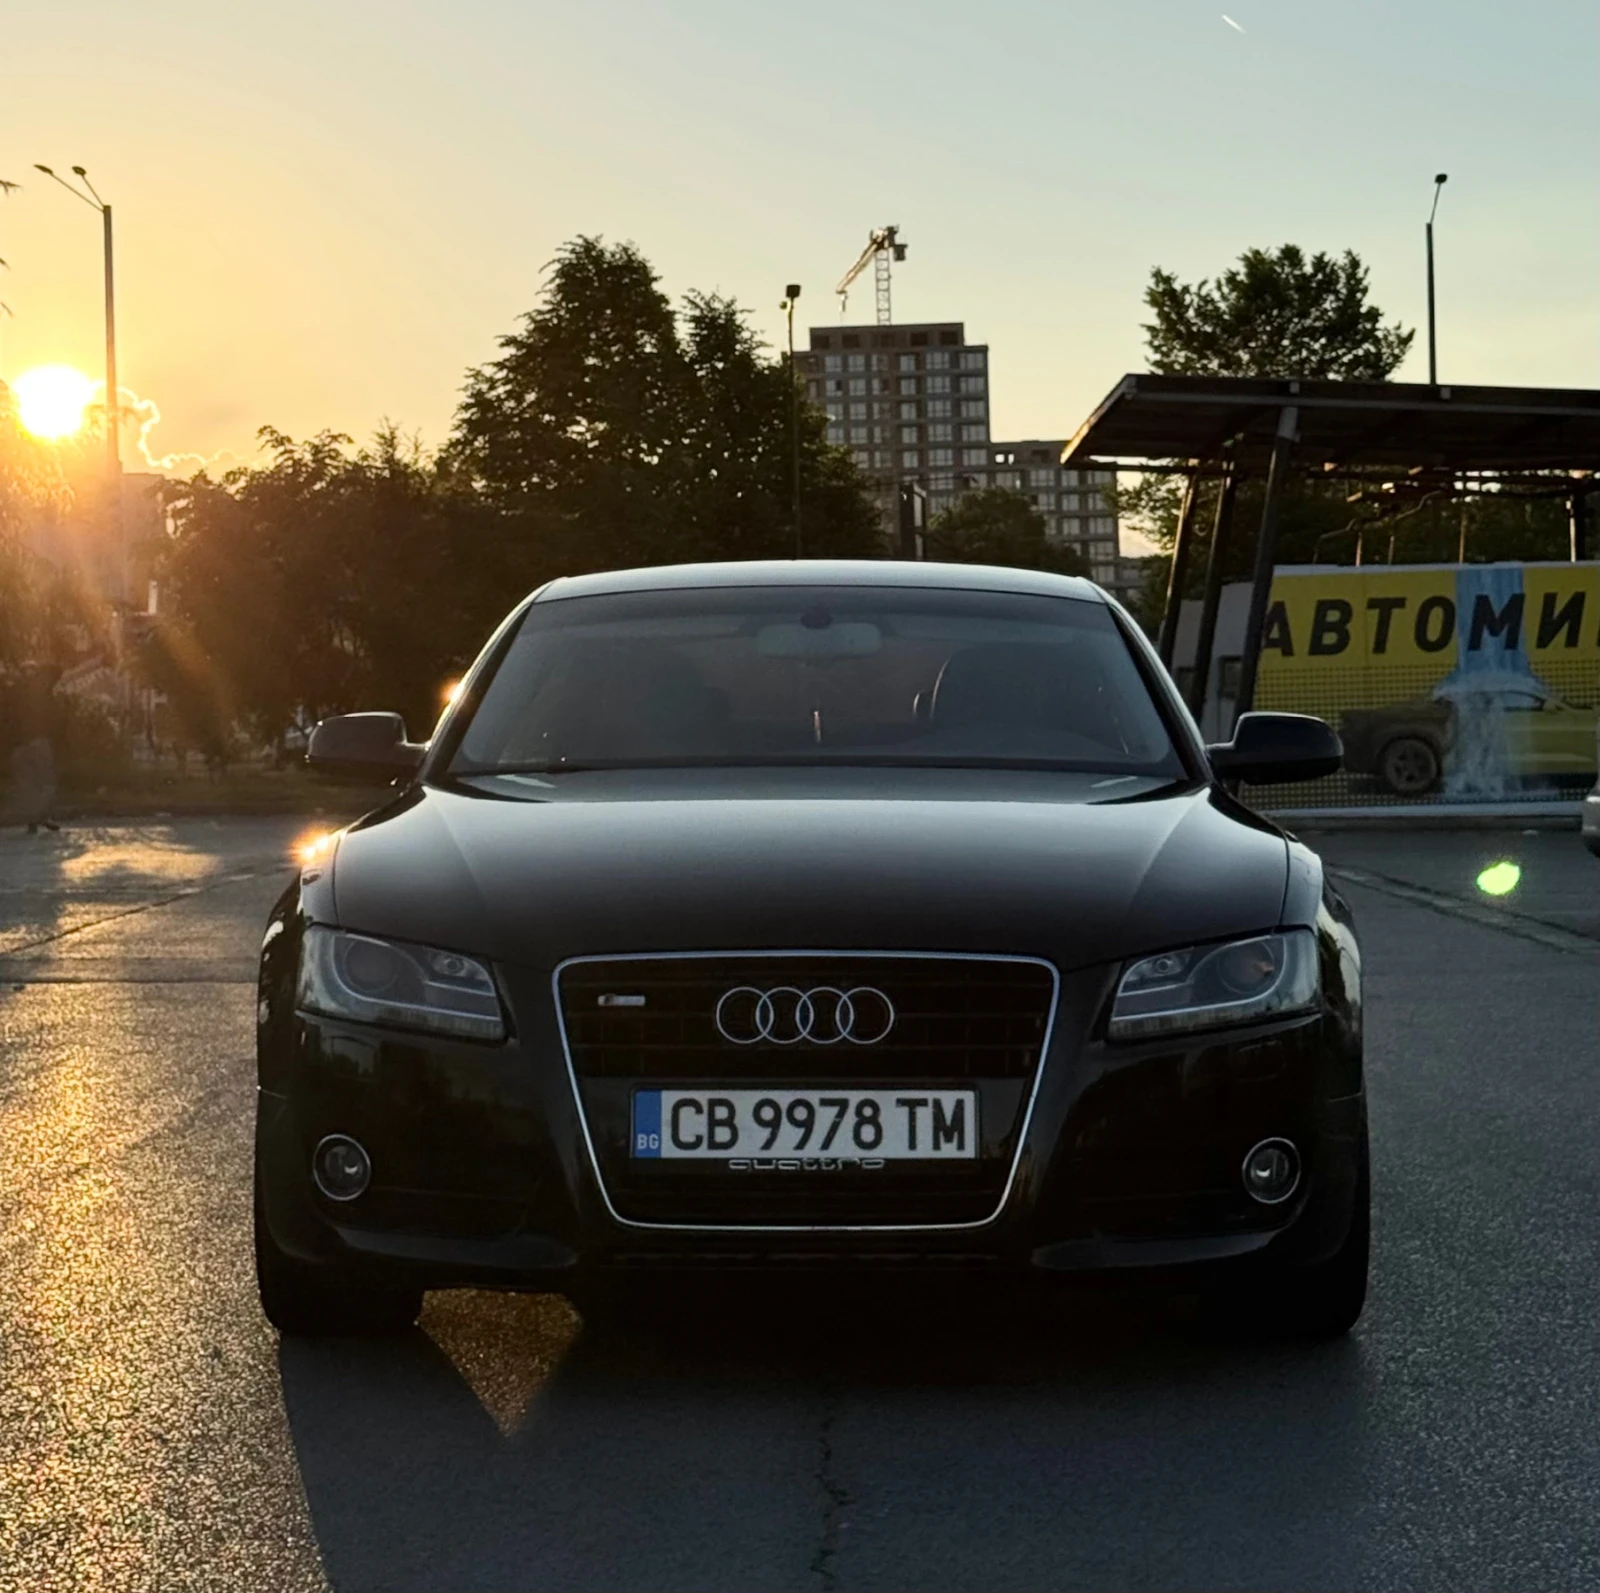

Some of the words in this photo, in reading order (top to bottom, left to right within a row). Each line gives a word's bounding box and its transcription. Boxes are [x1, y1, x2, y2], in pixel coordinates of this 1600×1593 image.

[1263, 591, 1600, 656] АВТОМИ
[637, 1133, 660, 1150] BG
[671, 1097, 739, 1151] CB
[752, 1097, 883, 1151] 9978
[896, 1097, 966, 1151] TM
[728, 1157, 885, 1171] quattro
